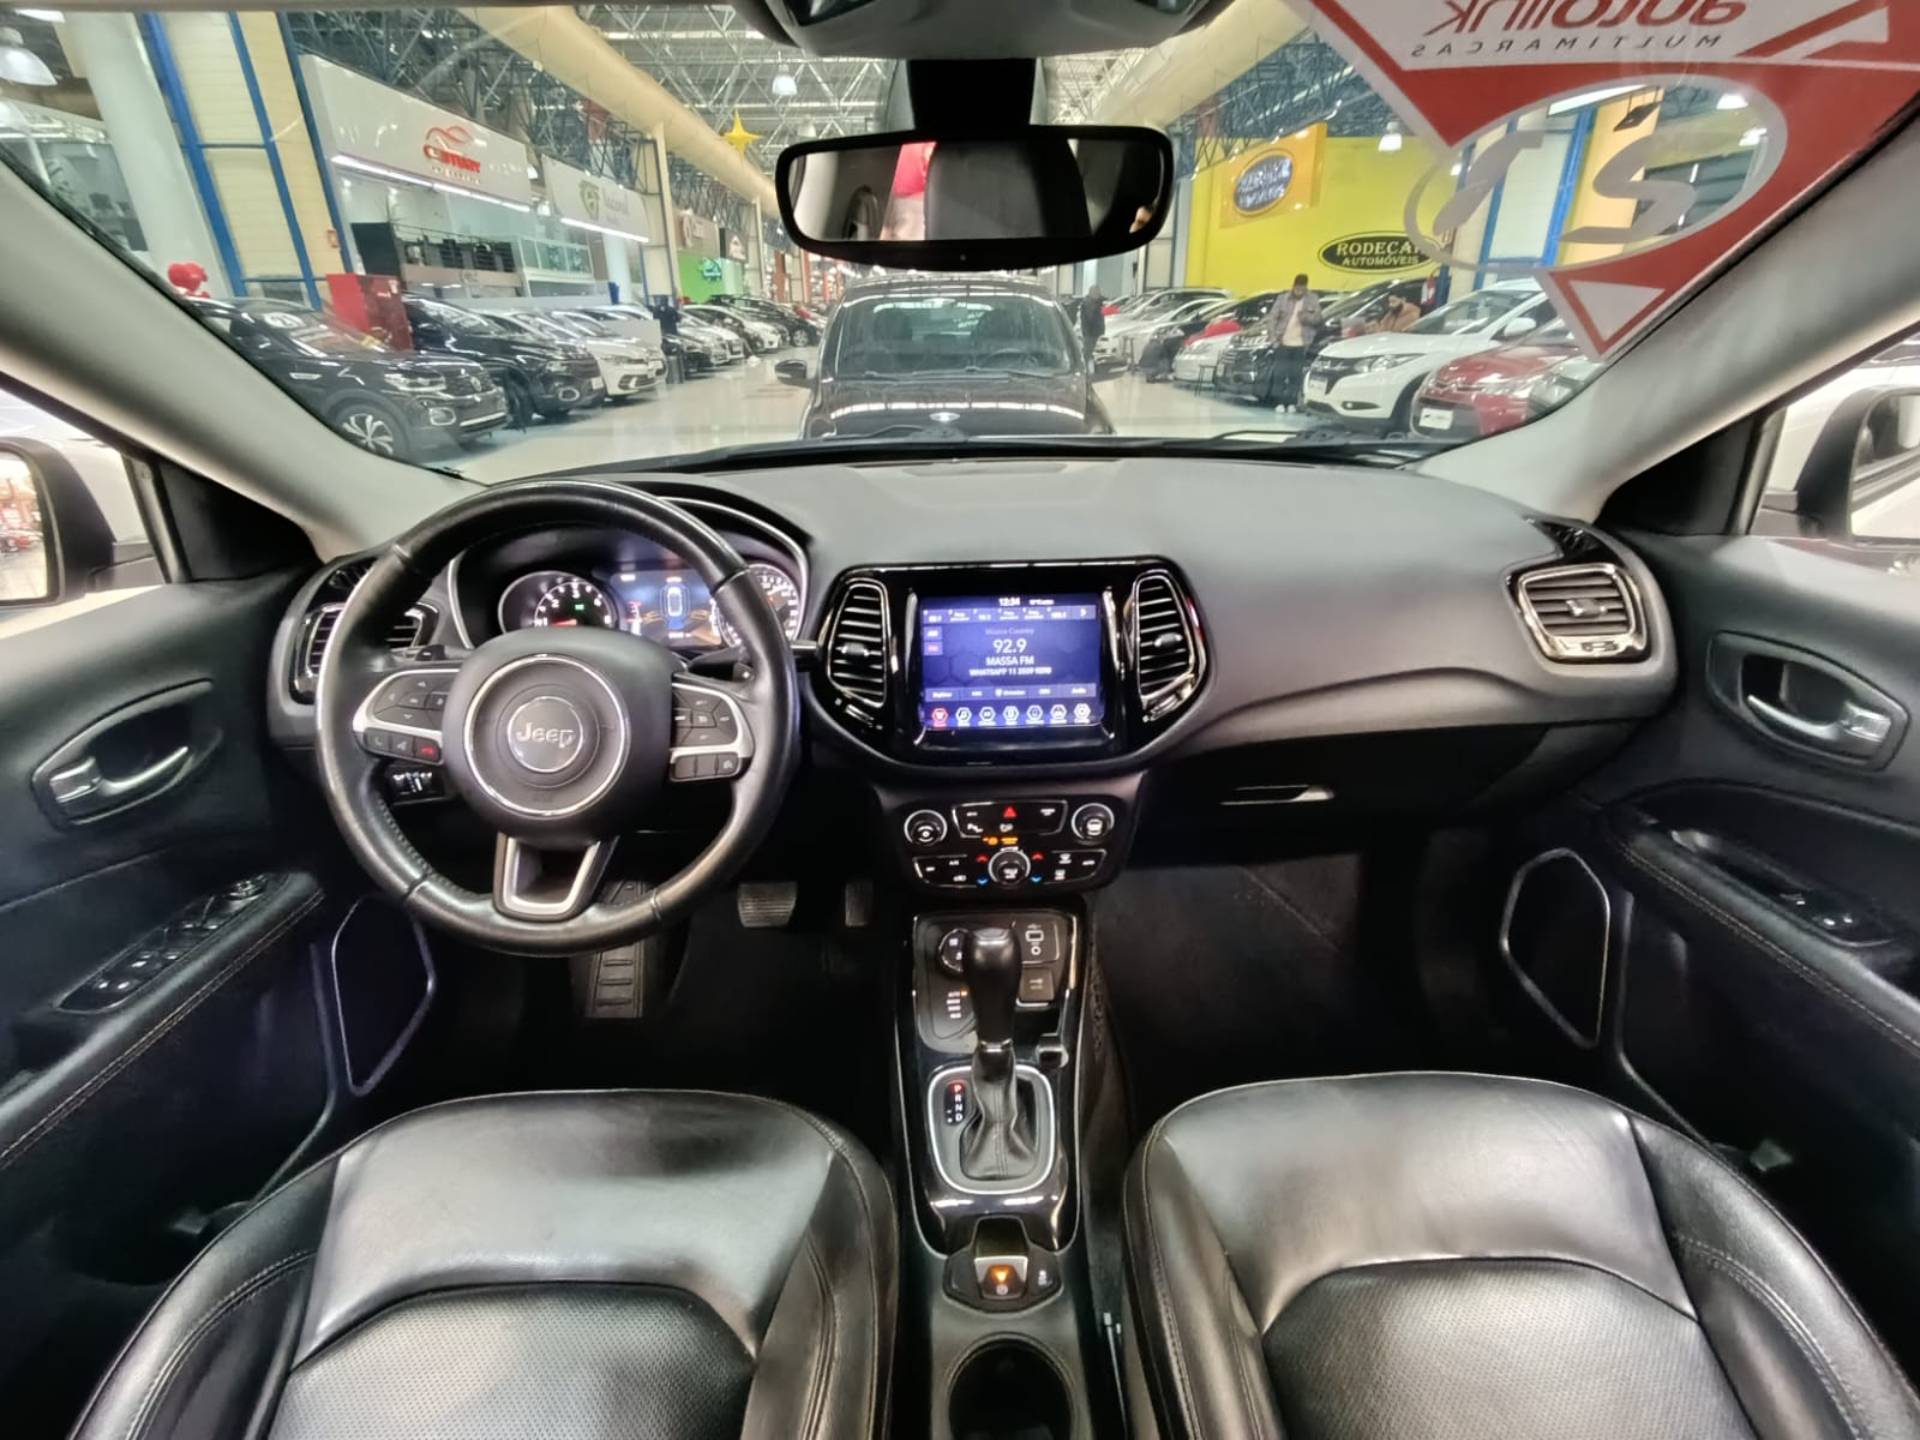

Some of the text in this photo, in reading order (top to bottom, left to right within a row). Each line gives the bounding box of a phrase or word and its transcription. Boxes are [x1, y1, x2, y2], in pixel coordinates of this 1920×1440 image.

[1336, 240, 1420, 257] RODECA
[992, 637, 1027, 654] 92.9
[985, 655, 1035, 666] MASSA FM
[516, 722, 576, 748] Jeep
